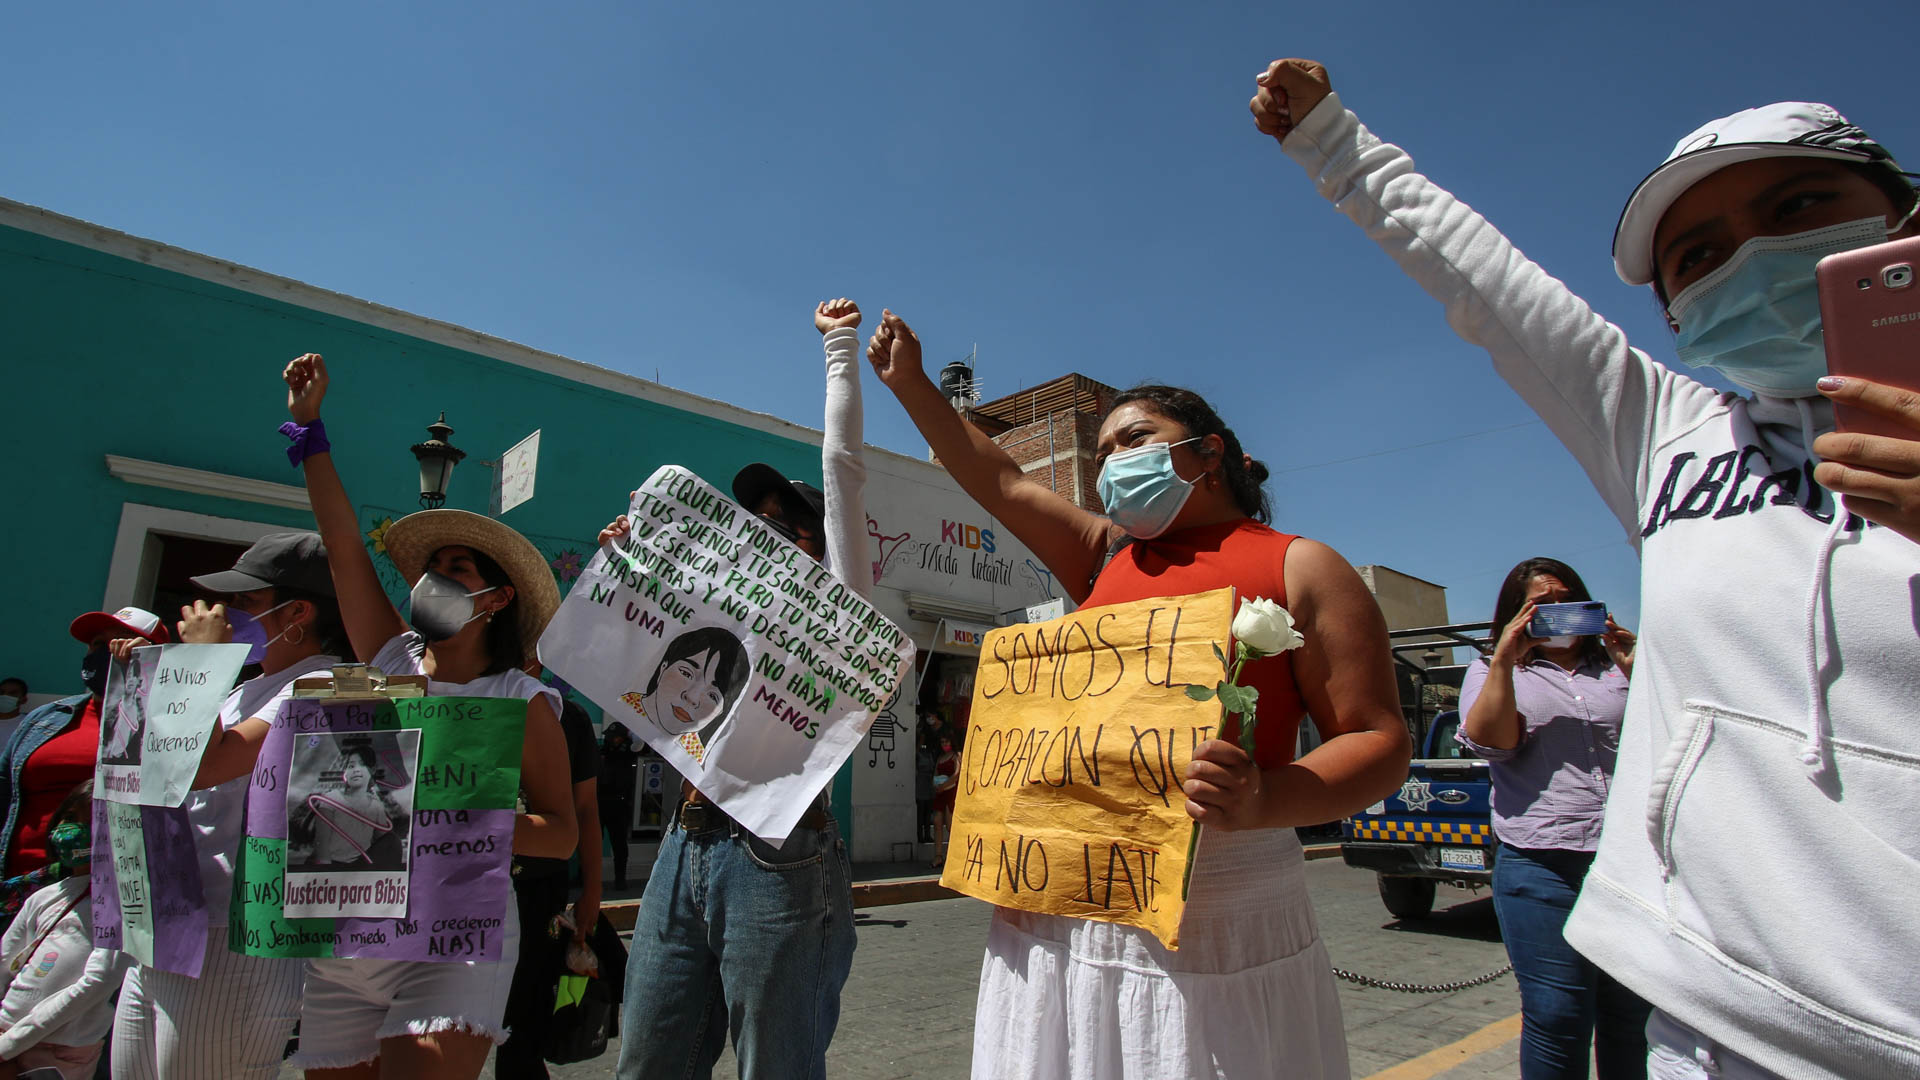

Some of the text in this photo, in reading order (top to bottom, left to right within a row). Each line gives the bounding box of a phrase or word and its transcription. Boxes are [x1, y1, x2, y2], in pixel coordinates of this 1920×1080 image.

[654, 468, 736, 530] PEQUEÑA
[736, 519, 801, 577] MONSE,
[803, 560, 831, 590] TE
[942, 519, 996, 553] KIDS
[639, 491, 901, 676] TUS SUEÑOS, TU SONRISA, TU SER,
[972, 551, 1014, 586] Infantil
[600, 554, 695, 625] HASTA QUE
[631, 514, 896, 693] TU ESENCIA PERO TU VOZ SOMOS
[590, 582, 664, 639] NI UNA
[622, 536, 883, 713] NOSOTRAS Y NO DESCANSAREMOS
[954, 629, 980, 645] KIDS
[982, 607, 1193, 700] SOMOS EL
[159, 667, 212, 685] #Vivas
[755, 652, 831, 714] NO HAYA
[167, 698, 189, 715] nos
[271, 701, 484, 731] usticia Para Monse
[753, 684, 819, 739] MENOS
[147, 732, 202, 753] Queremos
[965, 711, 1103, 797] CORAZÓN
[252, 754, 277, 792] Nos
[421, 763, 477, 787] #Ni
[416, 835, 496, 857] menos
[962, 833, 984, 883] YA
[996, 835, 1048, 893] NO
[285, 877, 407, 912] Justicia para Bibis
[267, 920, 341, 949] Sembraron
[396, 915, 501, 938] Nos crecieron
[428, 930, 486, 956] ALAS!
